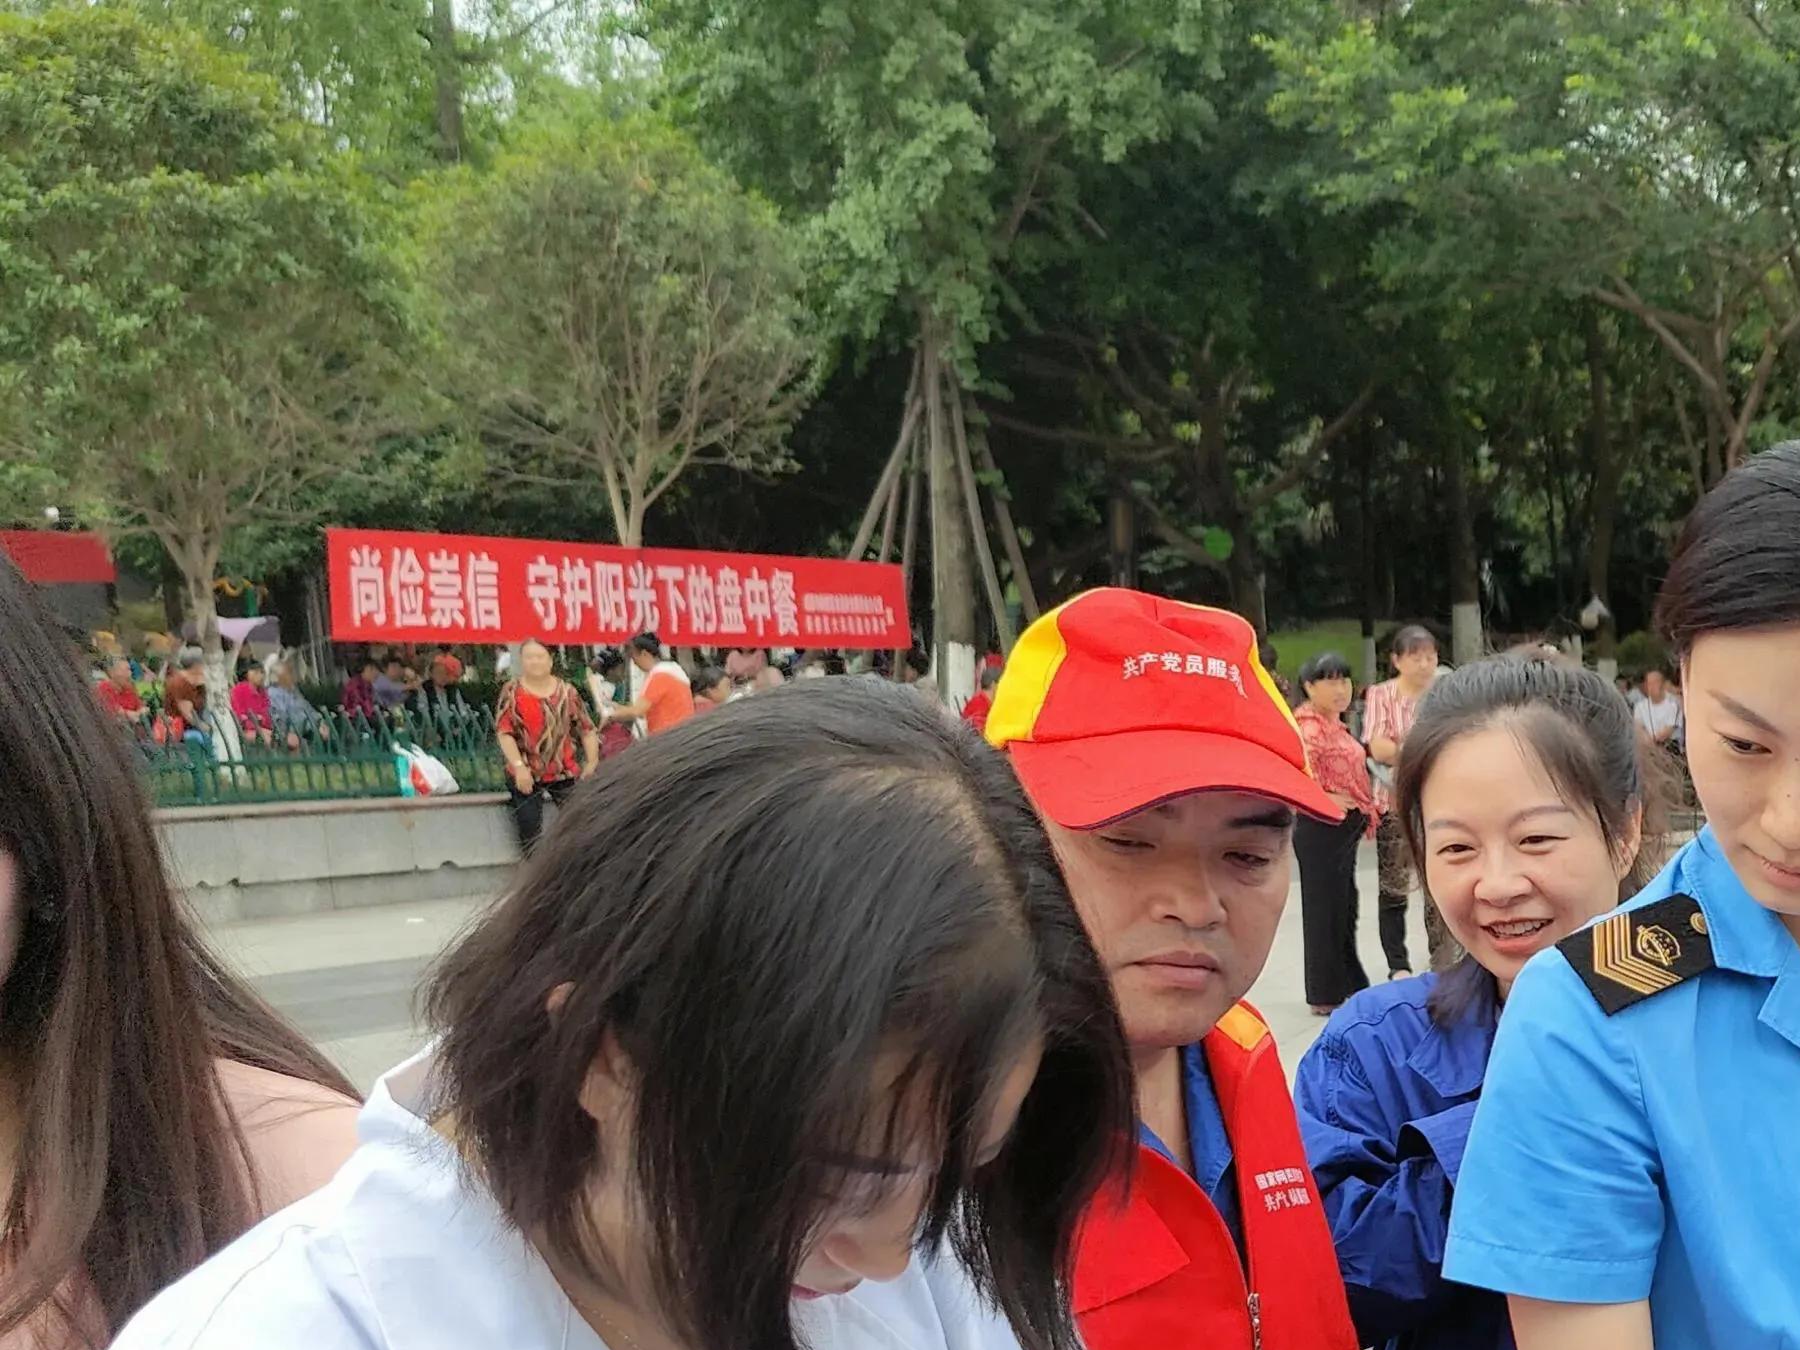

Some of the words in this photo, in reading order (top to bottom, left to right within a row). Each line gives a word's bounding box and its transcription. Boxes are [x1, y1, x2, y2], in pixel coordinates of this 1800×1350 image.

[350, 544, 501, 631] 尚俭崇信
[526, 554, 799, 638] 守护阳光下的盘中餐
